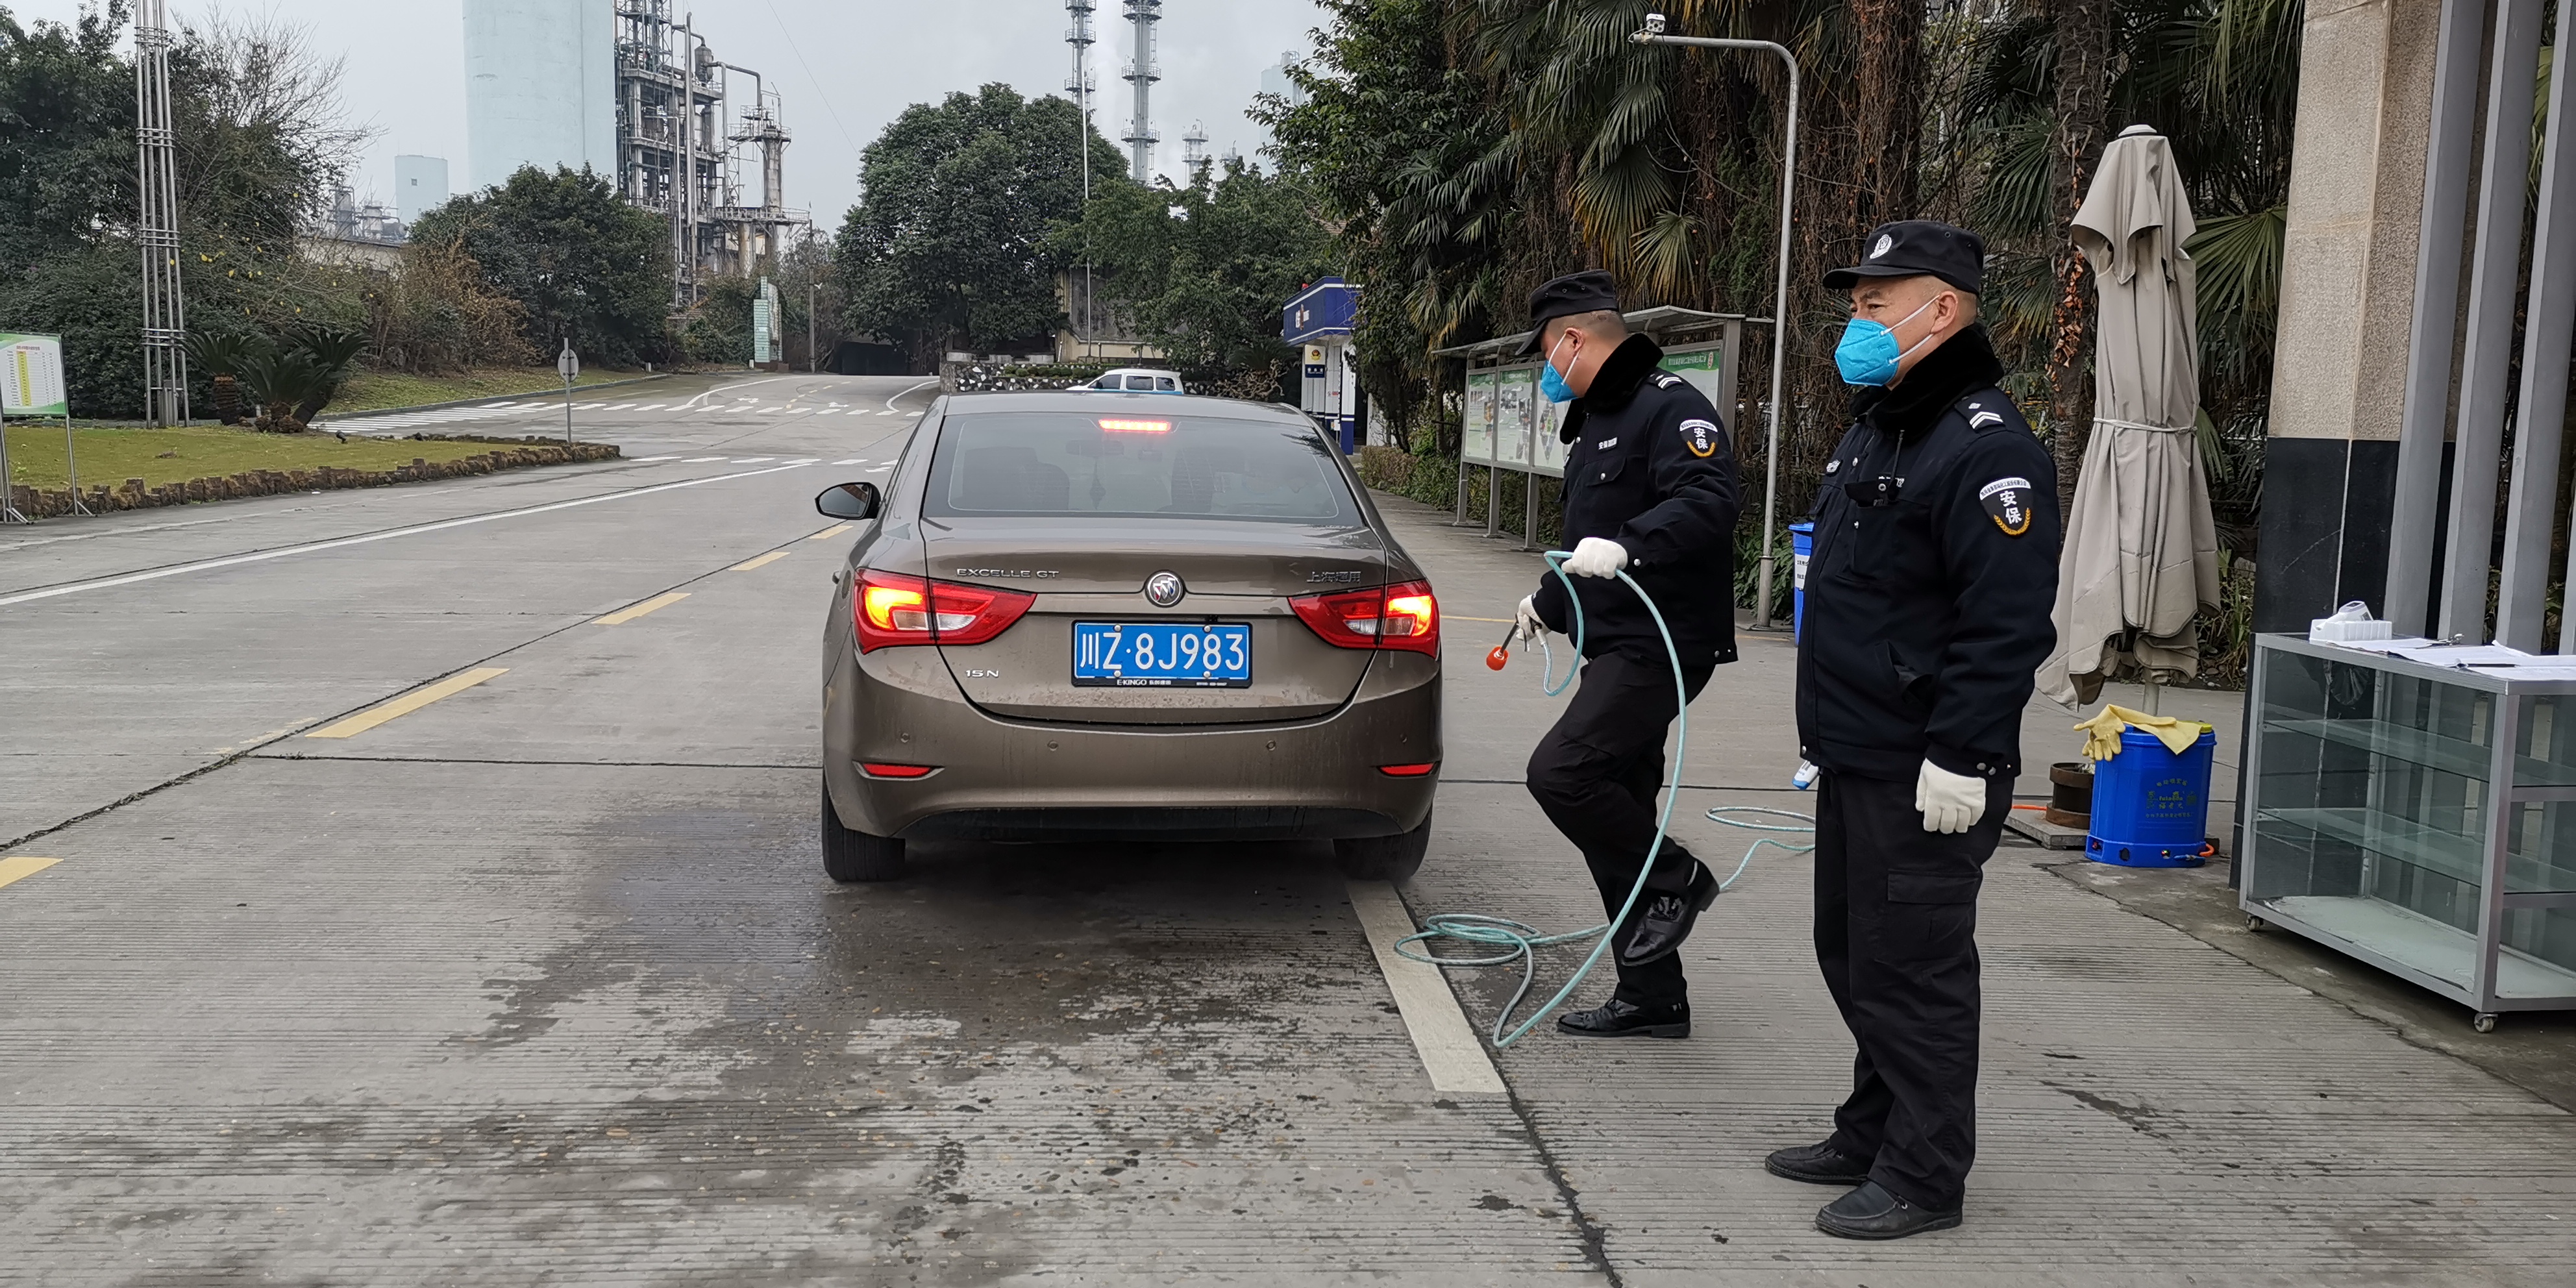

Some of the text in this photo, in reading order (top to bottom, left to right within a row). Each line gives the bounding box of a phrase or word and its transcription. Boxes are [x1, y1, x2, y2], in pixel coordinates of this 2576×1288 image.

[1694, 428, 1708, 449] 安保
[2000, 490, 2022, 524] 安保
[957, 568, 1031, 577] EXCELLE
[1306, 571, 1361, 583] 上海通用
